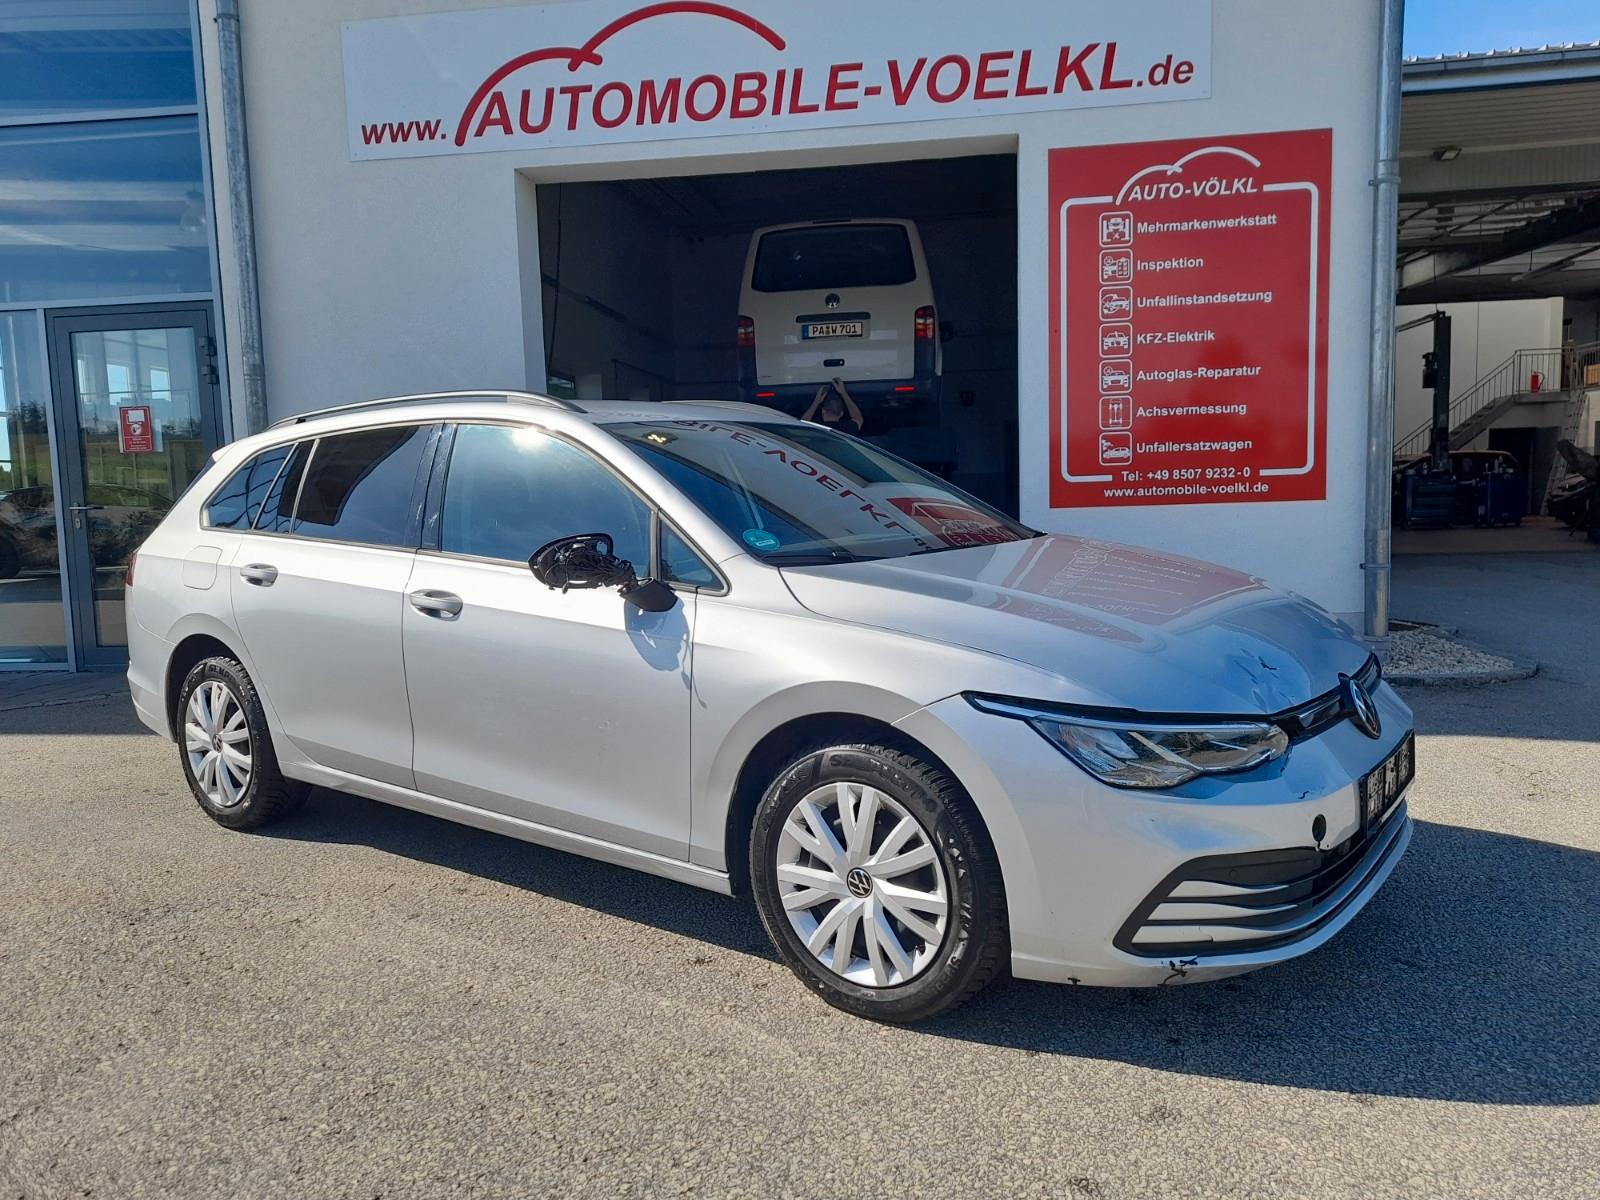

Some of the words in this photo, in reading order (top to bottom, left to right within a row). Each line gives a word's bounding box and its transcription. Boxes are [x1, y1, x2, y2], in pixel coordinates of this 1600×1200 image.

[1128, 177, 1258, 203] AUTO-VÖLKL
[1137, 213, 1277, 234] Mehrmarkenwerkstatt
[1137, 256, 1204, 273] Inspektion
[1137, 289, 1273, 309] Unfallinstandsetzung
[1136, 330, 1215, 344] KFZ-Elektrik
[1136, 365, 1262, 383] Autoglas-Reparatur
[1136, 402, 1248, 419] Achsvermessung
[1136, 438, 1253, 455] Unfallersatzwagen
[1121, 471, 1143, 482] Tel:
[1146, 469, 1170, 480] +49
[1173, 468, 1202, 480] 8507
[1103, 481, 1270, 498] www.automobile-voelkl.de
